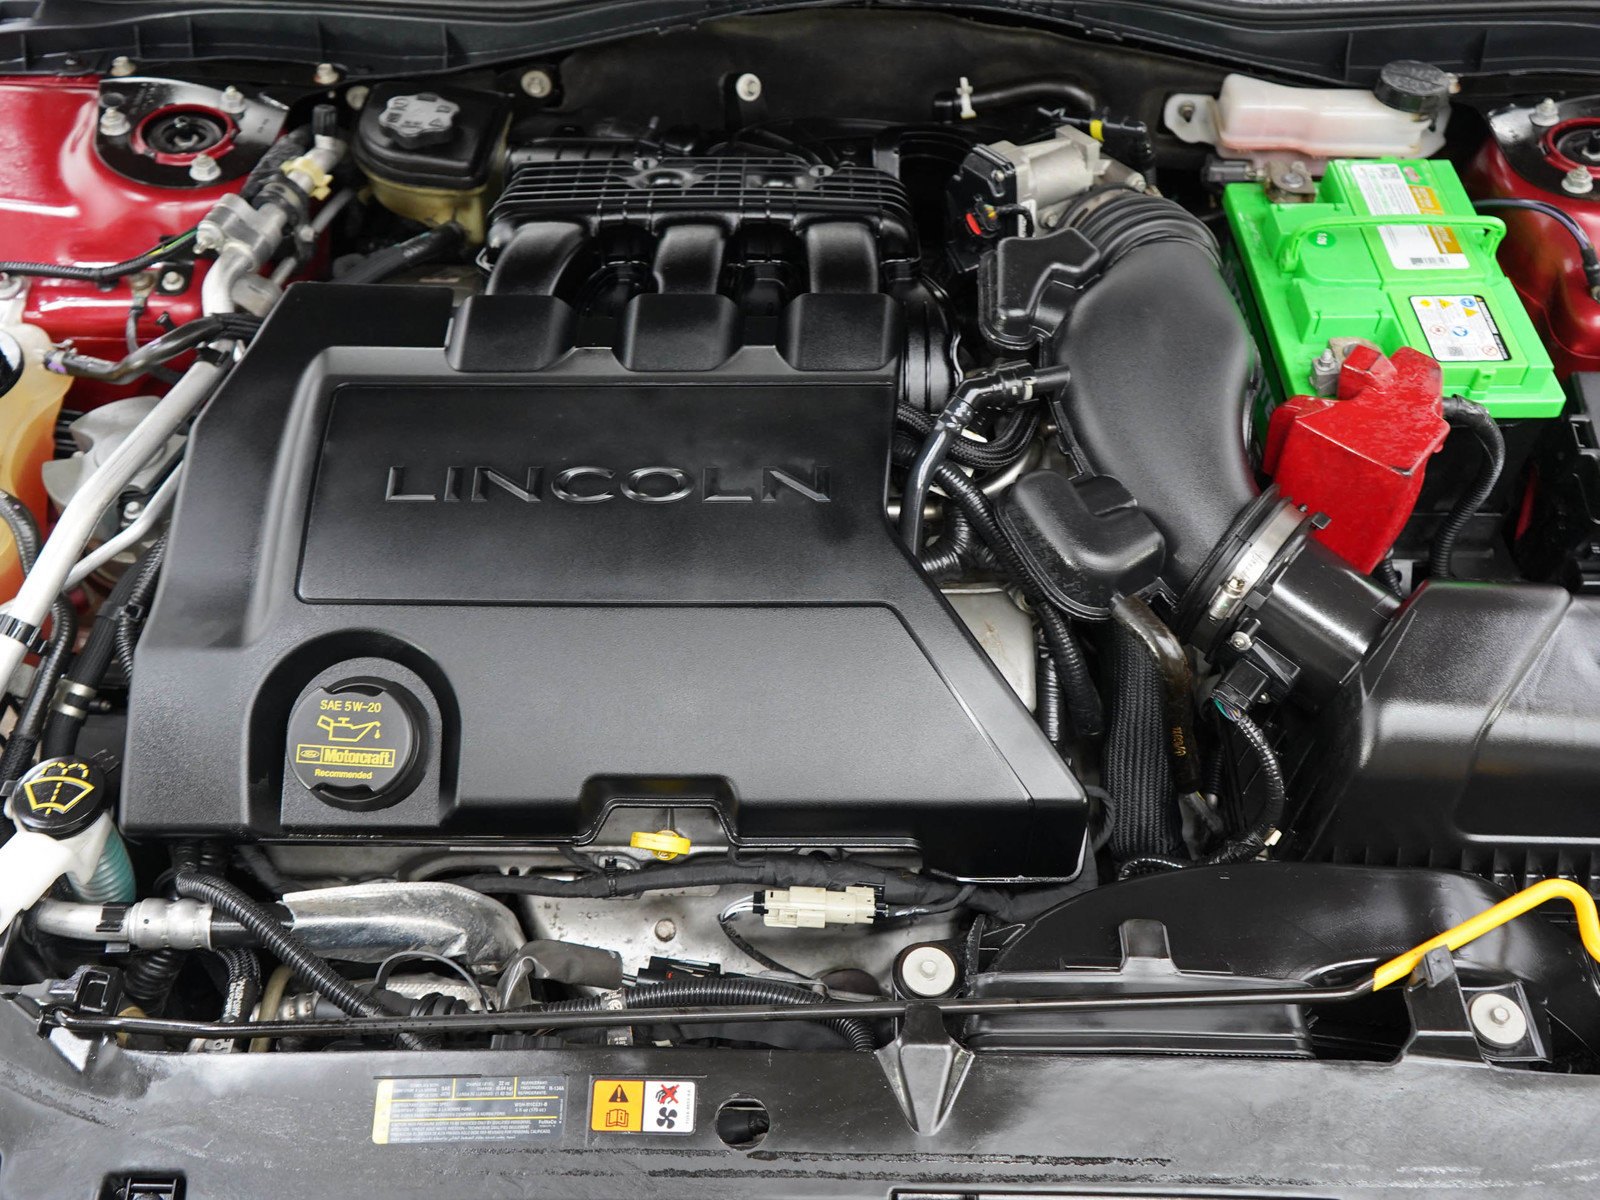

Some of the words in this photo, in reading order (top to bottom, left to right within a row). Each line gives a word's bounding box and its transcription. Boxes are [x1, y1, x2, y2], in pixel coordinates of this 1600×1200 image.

[383, 466, 832, 503] LINCOLN
[320, 699, 342, 711] SAE
[344, 701, 382, 713] 5W-20
[314, 768, 373, 780] Recommended
